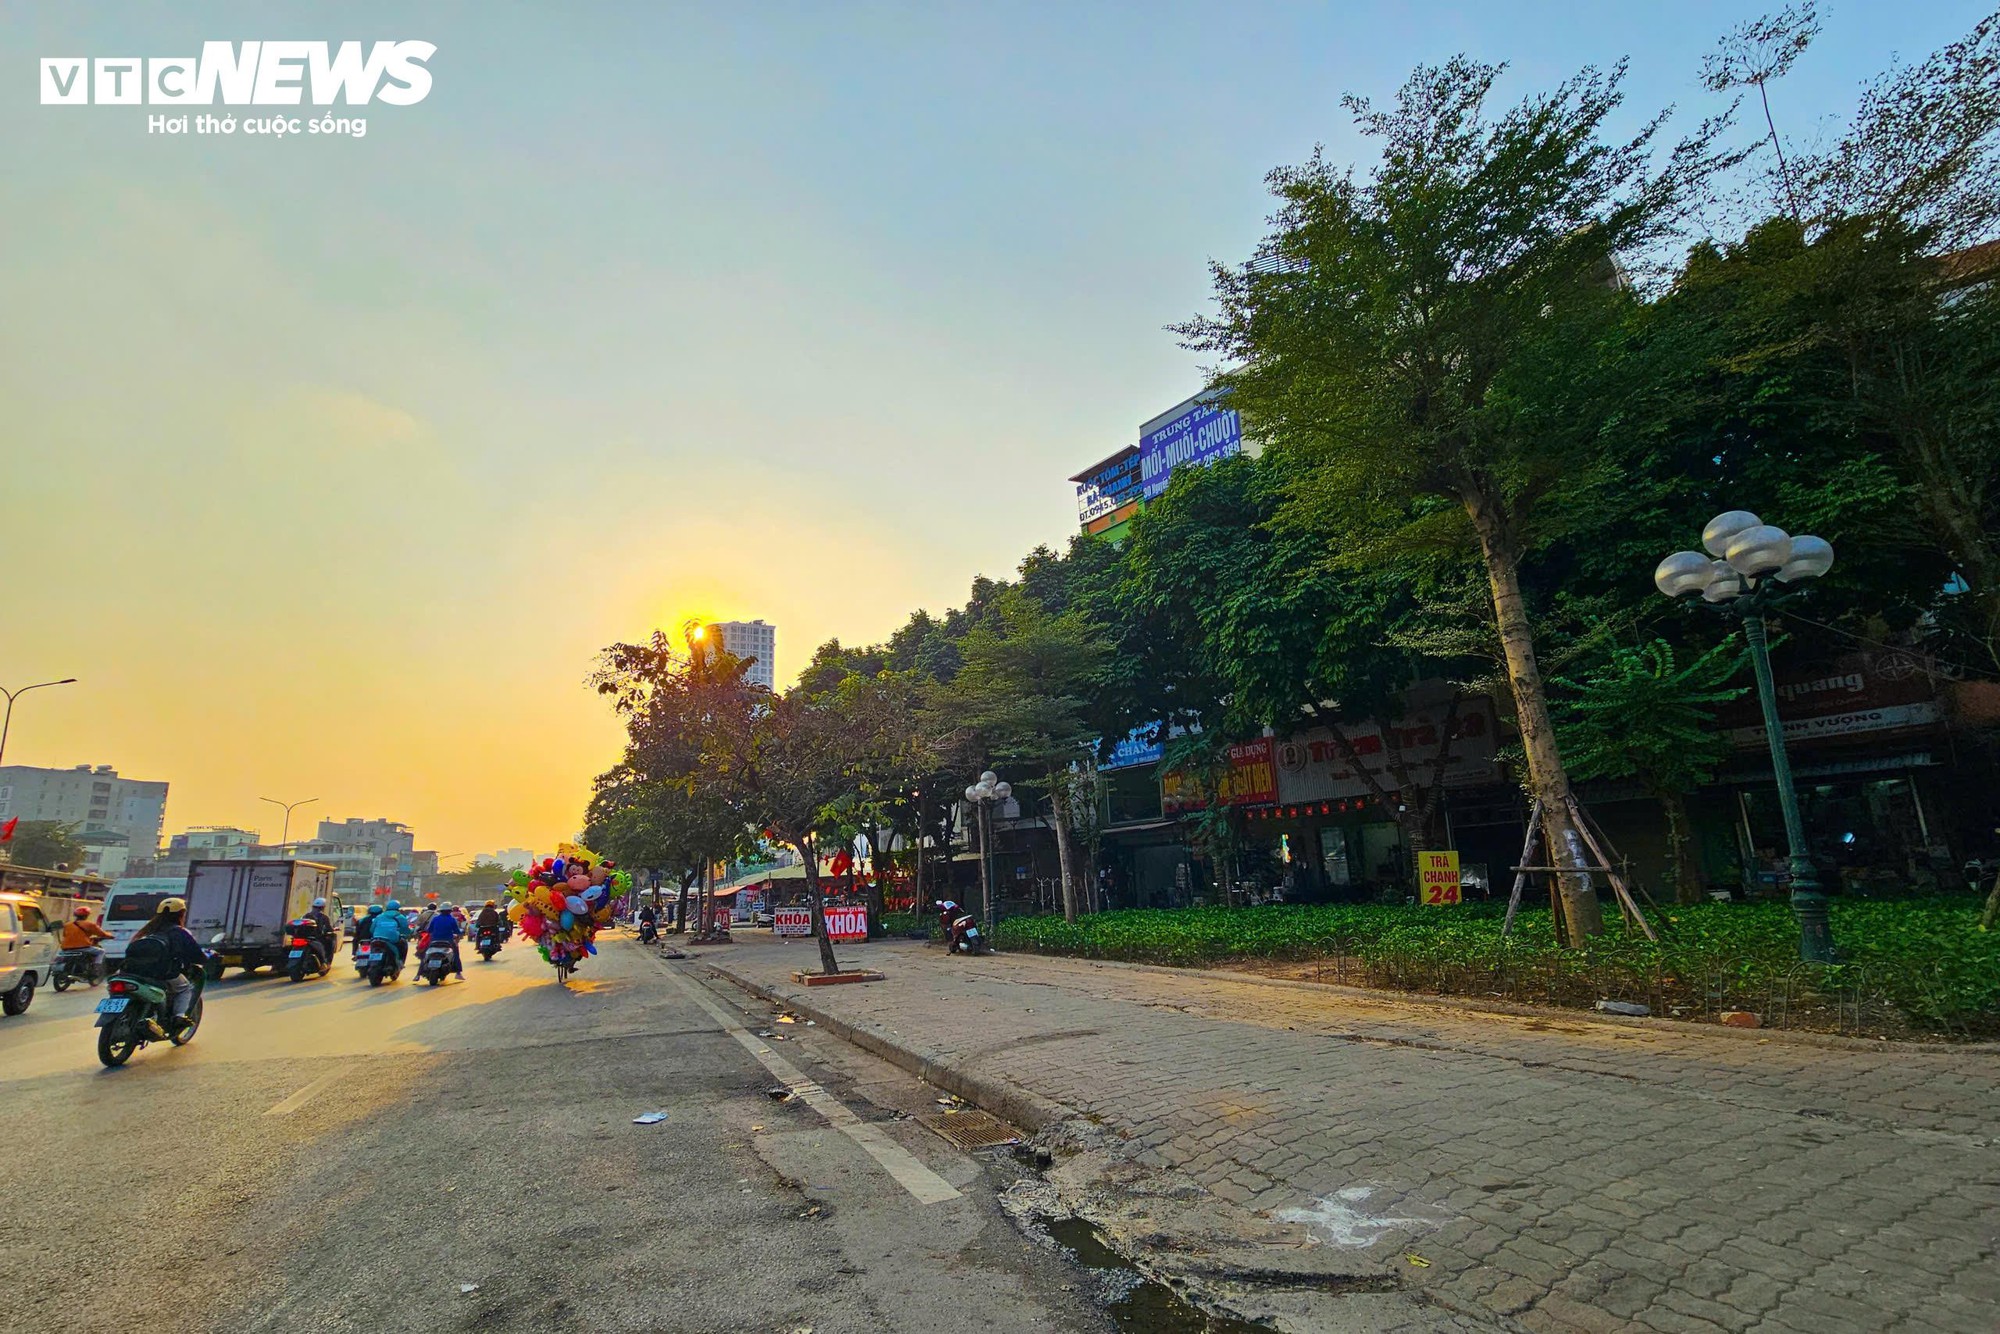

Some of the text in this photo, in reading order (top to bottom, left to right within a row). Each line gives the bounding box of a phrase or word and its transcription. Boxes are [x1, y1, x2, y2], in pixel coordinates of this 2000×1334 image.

[1152, 416, 1191, 445] TRUNG
[1423, 870, 1459, 883] CHANH
[1427, 885, 1459, 904] 24
[775, 911, 811, 925] KHÓA
[824, 911, 868, 935] KHÓA
